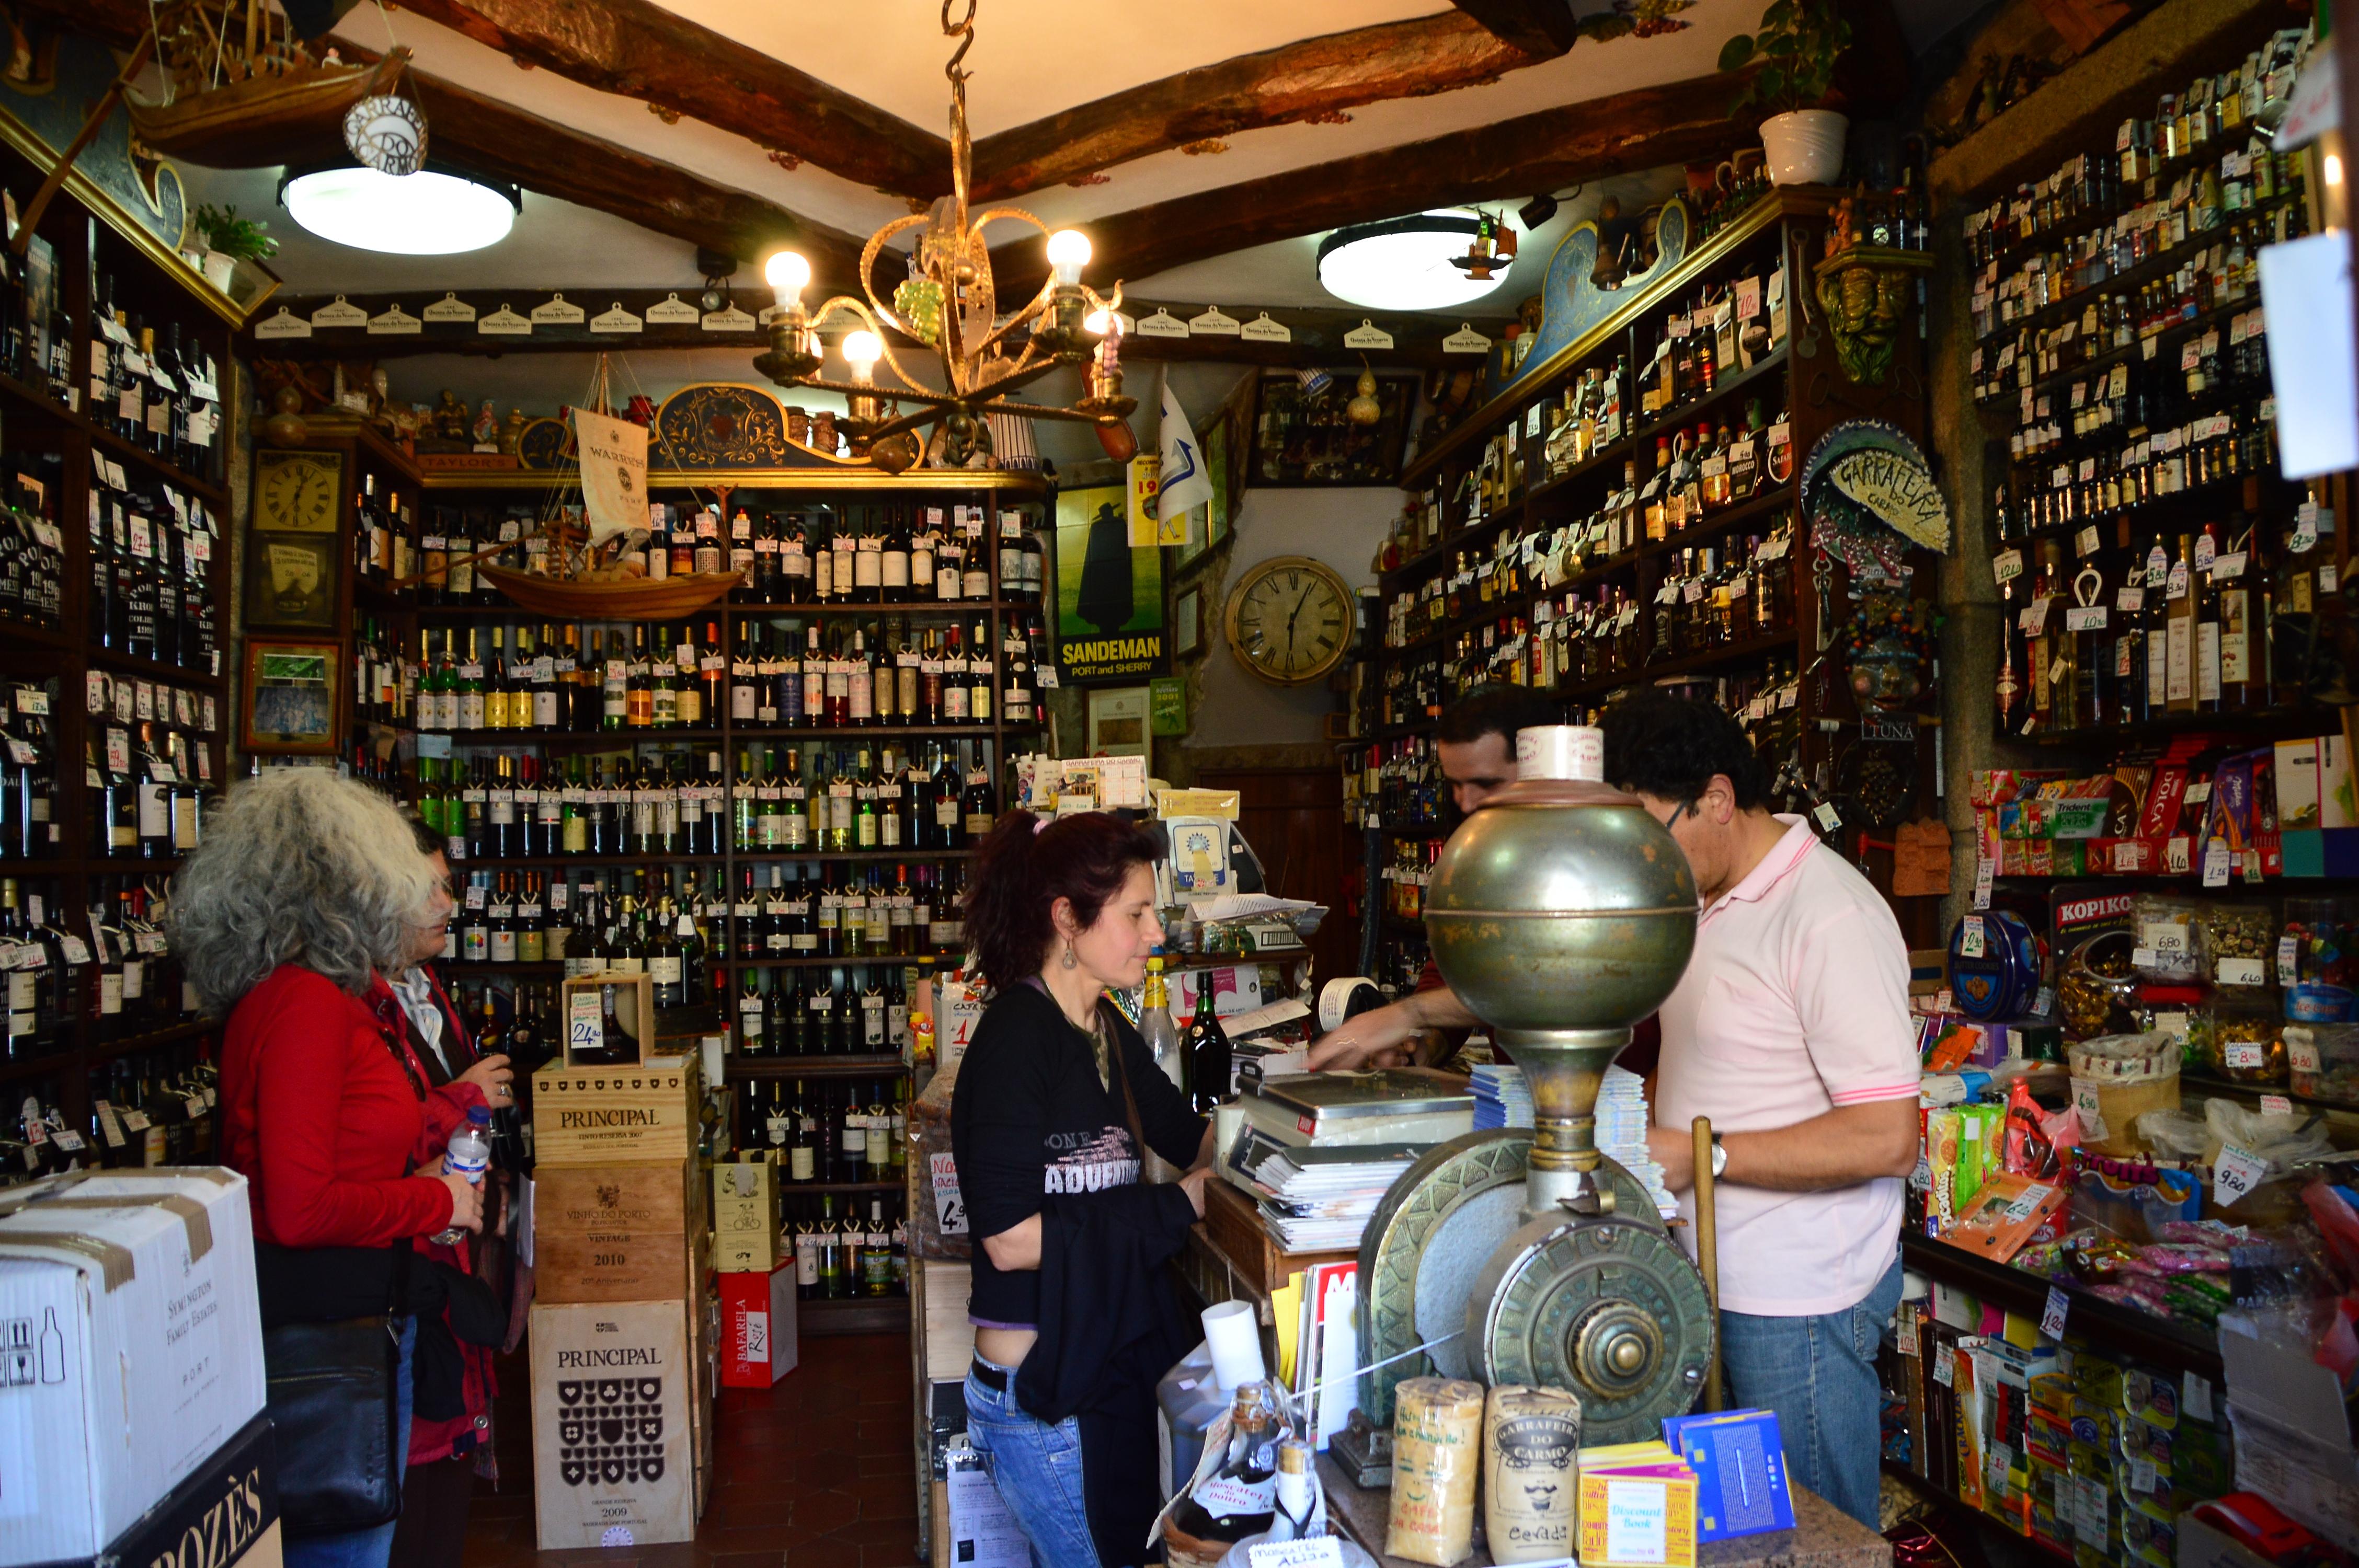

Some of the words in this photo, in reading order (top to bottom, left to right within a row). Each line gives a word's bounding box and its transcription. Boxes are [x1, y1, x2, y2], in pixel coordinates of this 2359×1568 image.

[380, 134, 408, 157] DO
[1732, 459, 1755, 475] MOROCCO
[1840, 457, 1941, 526] GARRAFEIRA
[1890, 491, 1904, 505] DO
[1062, 636, 1160, 665] SANDEMAN
[1072, 665, 1096, 677] PORT
[1097, 664, 1113, 675] and
[1115, 662, 1152, 674] SHERRY
[1870, 725, 1914, 738] TUNA
[2151, 771, 2174, 824] DOLCA
[589, 811, 602, 821] JMF
[613, 803, 631, 821] JP
[2057, 805, 2090, 814] Trident
[2061, 895, 2132, 922] KOPIKO
[1955, 962, 1975, 970] BUTTER
[1976, 962, 2000, 971] COOKIES
[2294, 999, 2309, 1013] Ice
[560, 1109, 660, 1128] PRINCIPAL
[2082, 1151, 2158, 1185] FRUITS
[566, 1210, 599, 1220] VINHO
[601, 1210, 616, 1220] DO
[617, 1210, 650, 1219] PORTO
[589, 1235, 631, 1243] VINTAGE
[593, 1254, 625, 1266] 2010
[167, 1279, 211, 1320] SYMINGTON
[166, 1321, 189, 1347] FAMILY
[192, 1300, 217, 1328] ESTATES
[736, 1298, 747, 1362] BAFARELA
[558, 1348, 662, 1368] PRINCIPAL
[182, 1356, 209, 1387] PORT
[1530, 1432, 1553, 1446] DO
[1513, 1445, 1567, 1463] CARMO
[1582, 1489, 1606, 1501] cultur
[150, 1466, 261, 1568] OZÈS
[602, 1508, 627, 1518] 2009
[1611, 1505, 1661, 1517] Discount
[1622, 1516, 1652, 1529] Book
[1666, 1525, 1689, 1537] story
